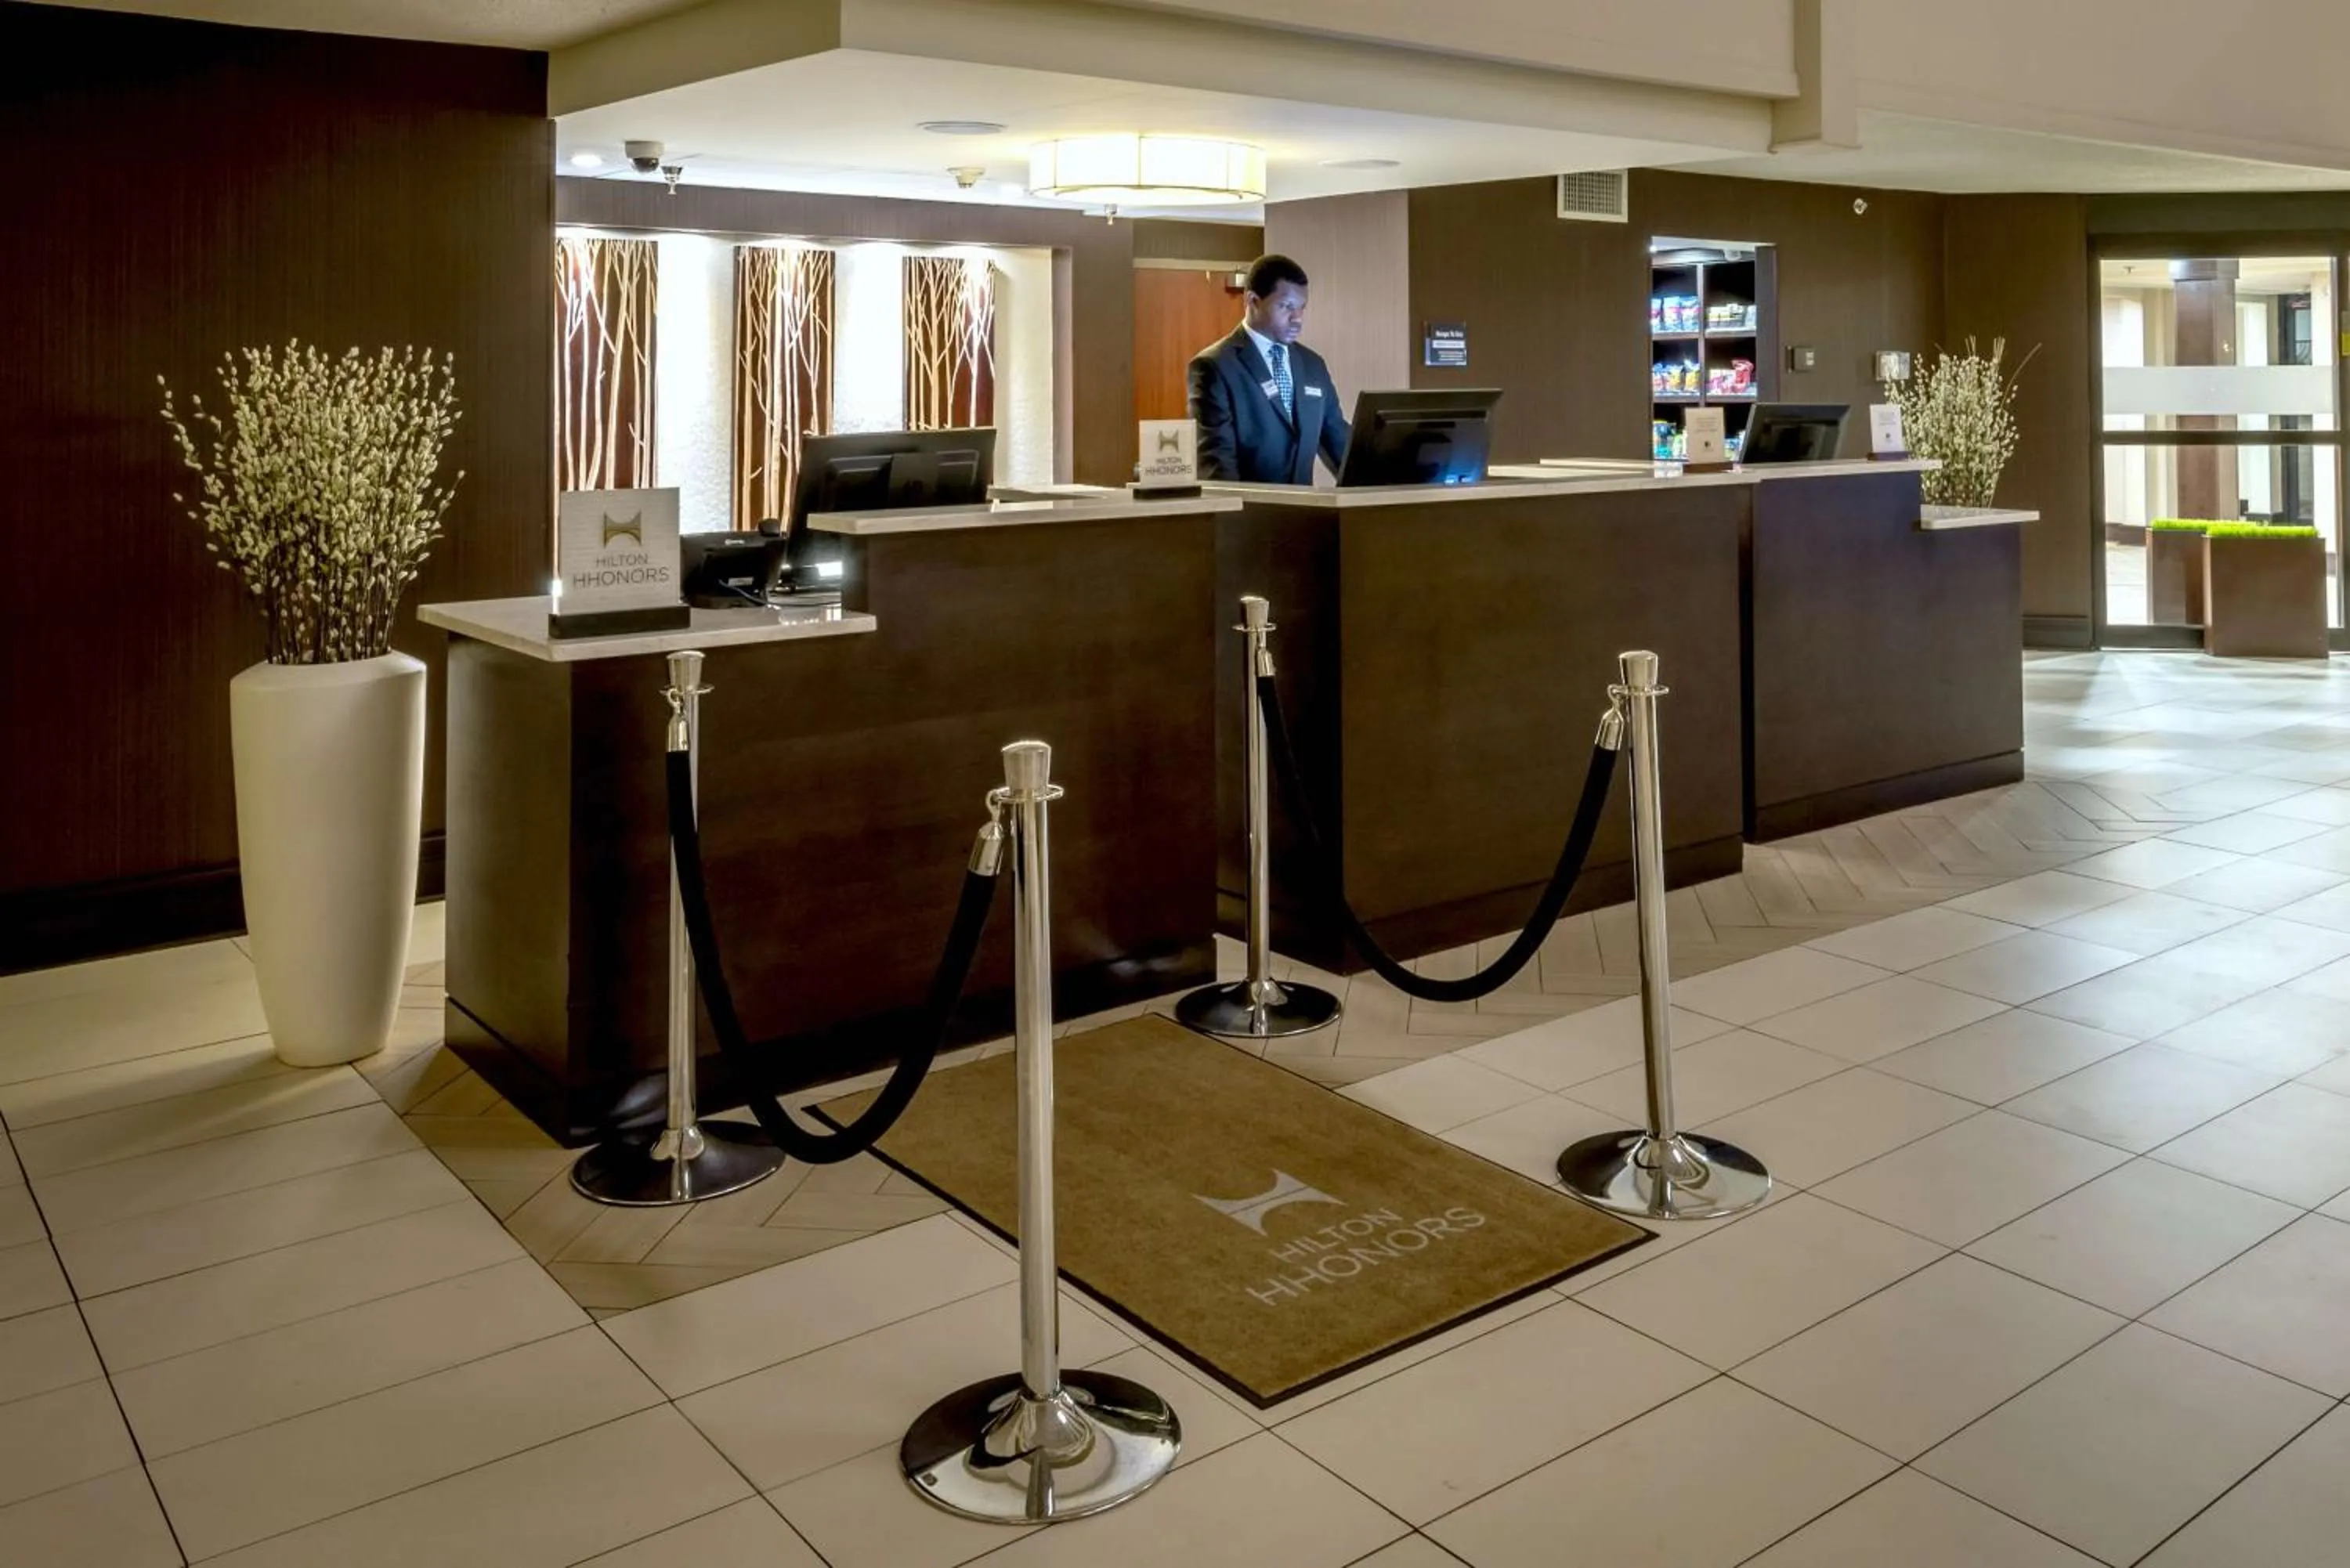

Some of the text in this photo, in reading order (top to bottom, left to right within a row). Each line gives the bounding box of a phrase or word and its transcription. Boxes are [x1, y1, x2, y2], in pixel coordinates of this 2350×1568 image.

[573, 566, 670, 587] HHONORS
[596, 553, 649, 567] HILTON
[1267, 1207, 1403, 1263] HILTON
[1246, 1206, 1487, 1306] HHONORS
